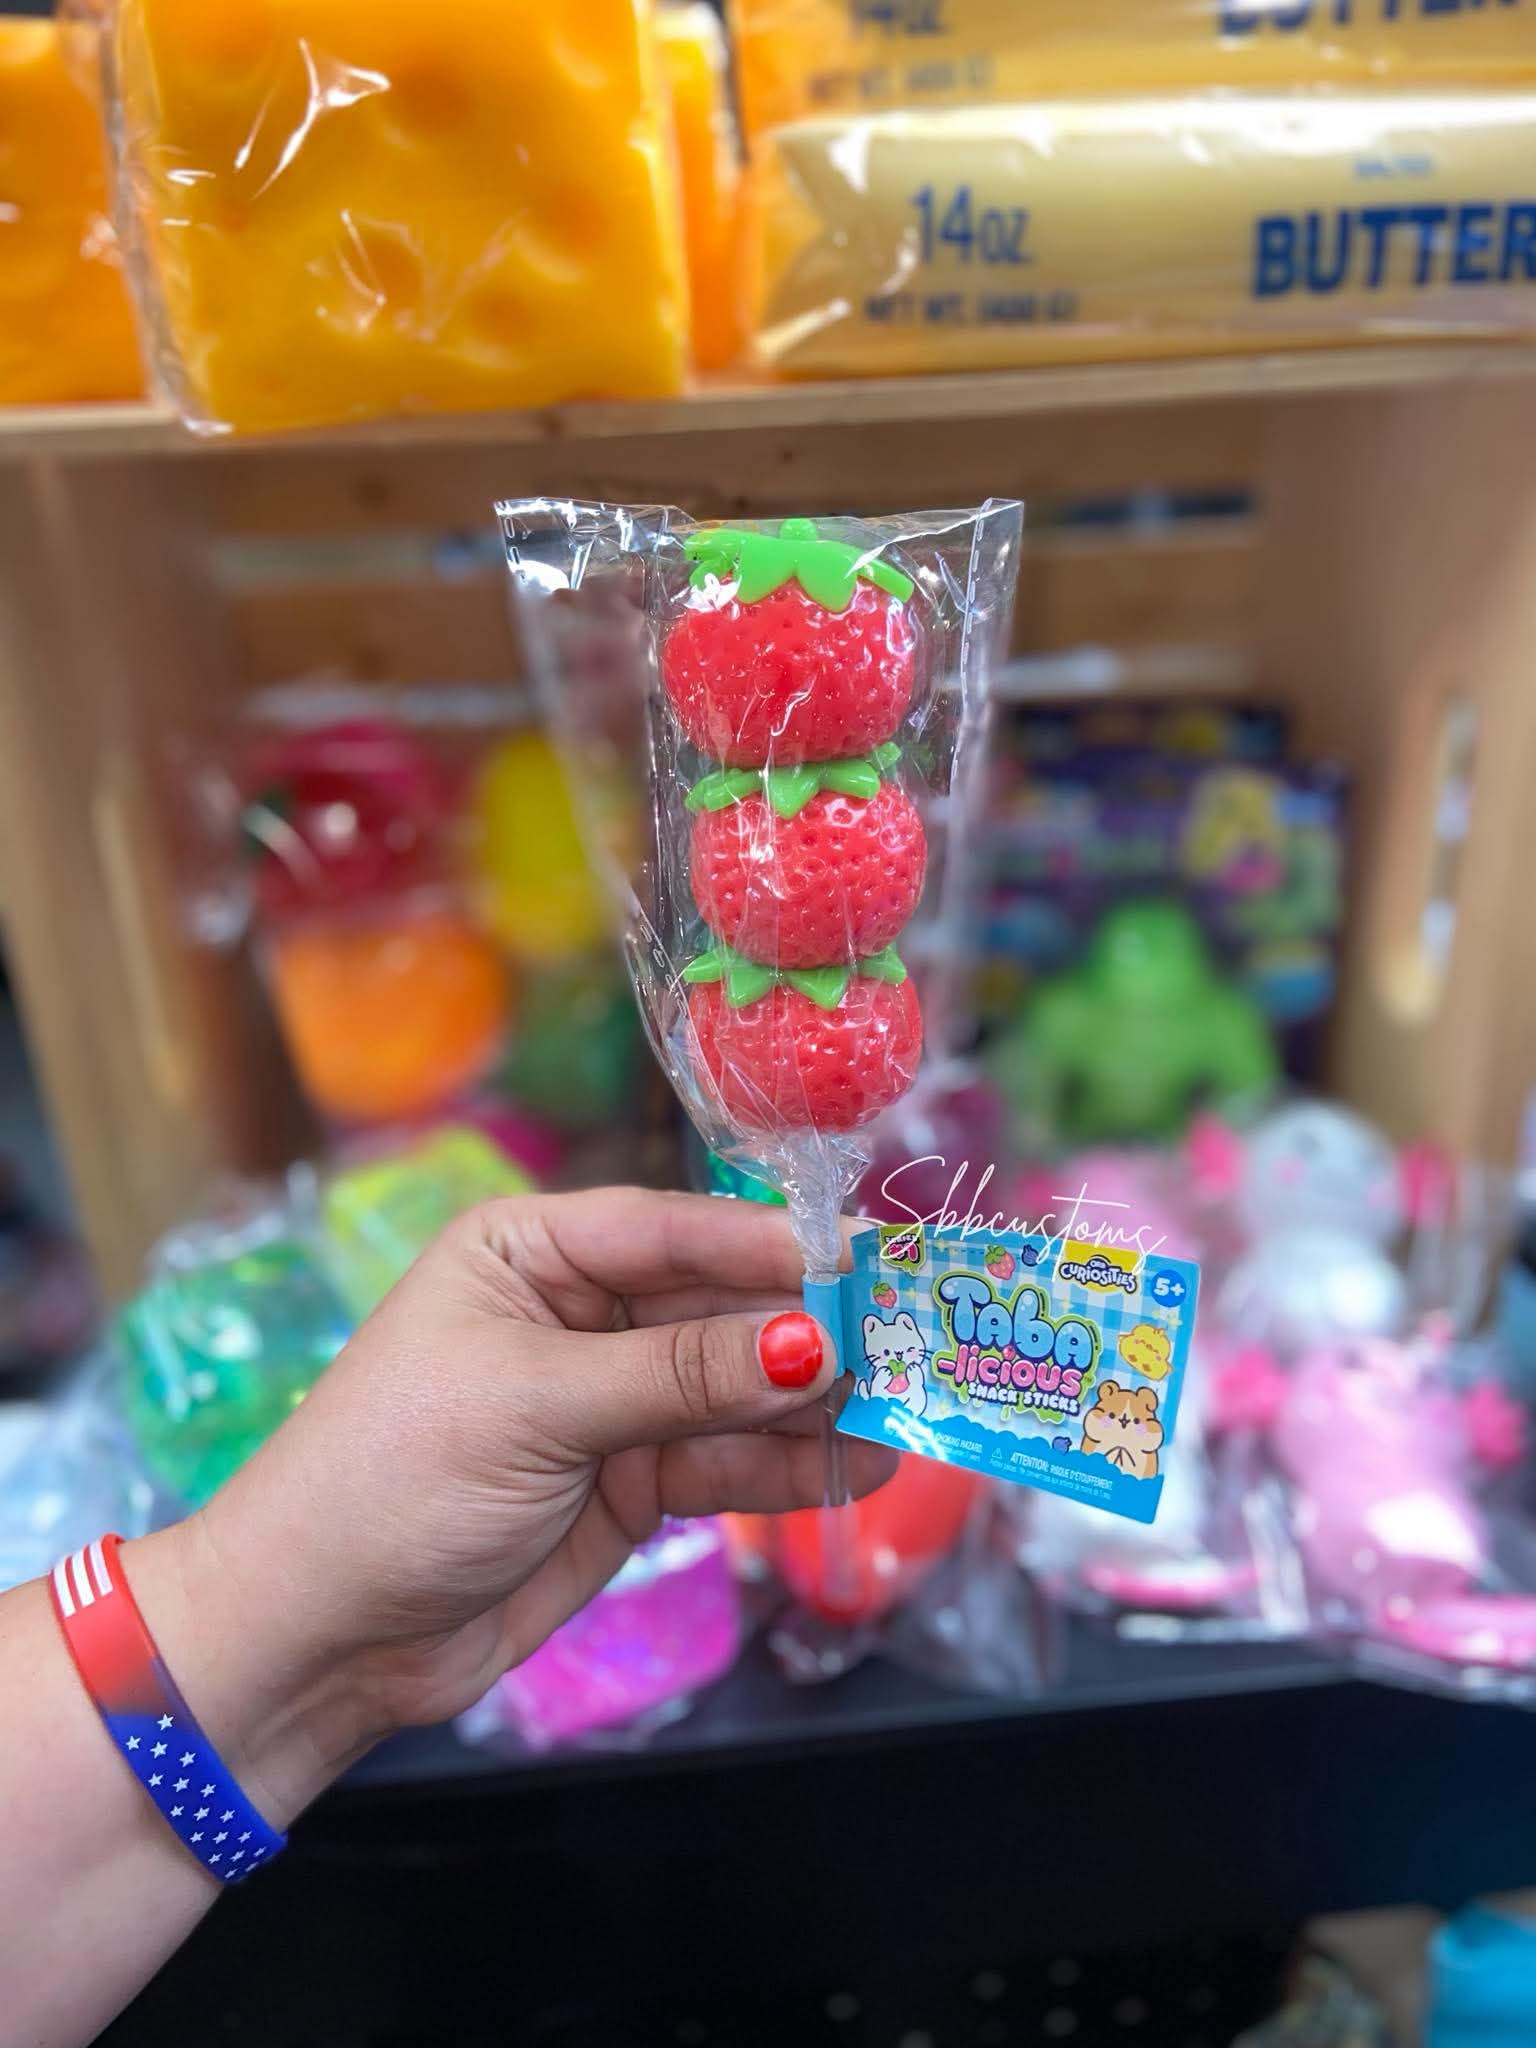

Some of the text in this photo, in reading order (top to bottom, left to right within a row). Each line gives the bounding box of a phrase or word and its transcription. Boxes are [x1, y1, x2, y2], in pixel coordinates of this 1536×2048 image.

[1252, 203, 1536, 300] BUTTER
[1153, 1277, 1185, 1297] 5+
[968, 1382, 1080, 1414] SNACK STICKS
[1010, 1452, 1050, 1473] ATTENTION:
